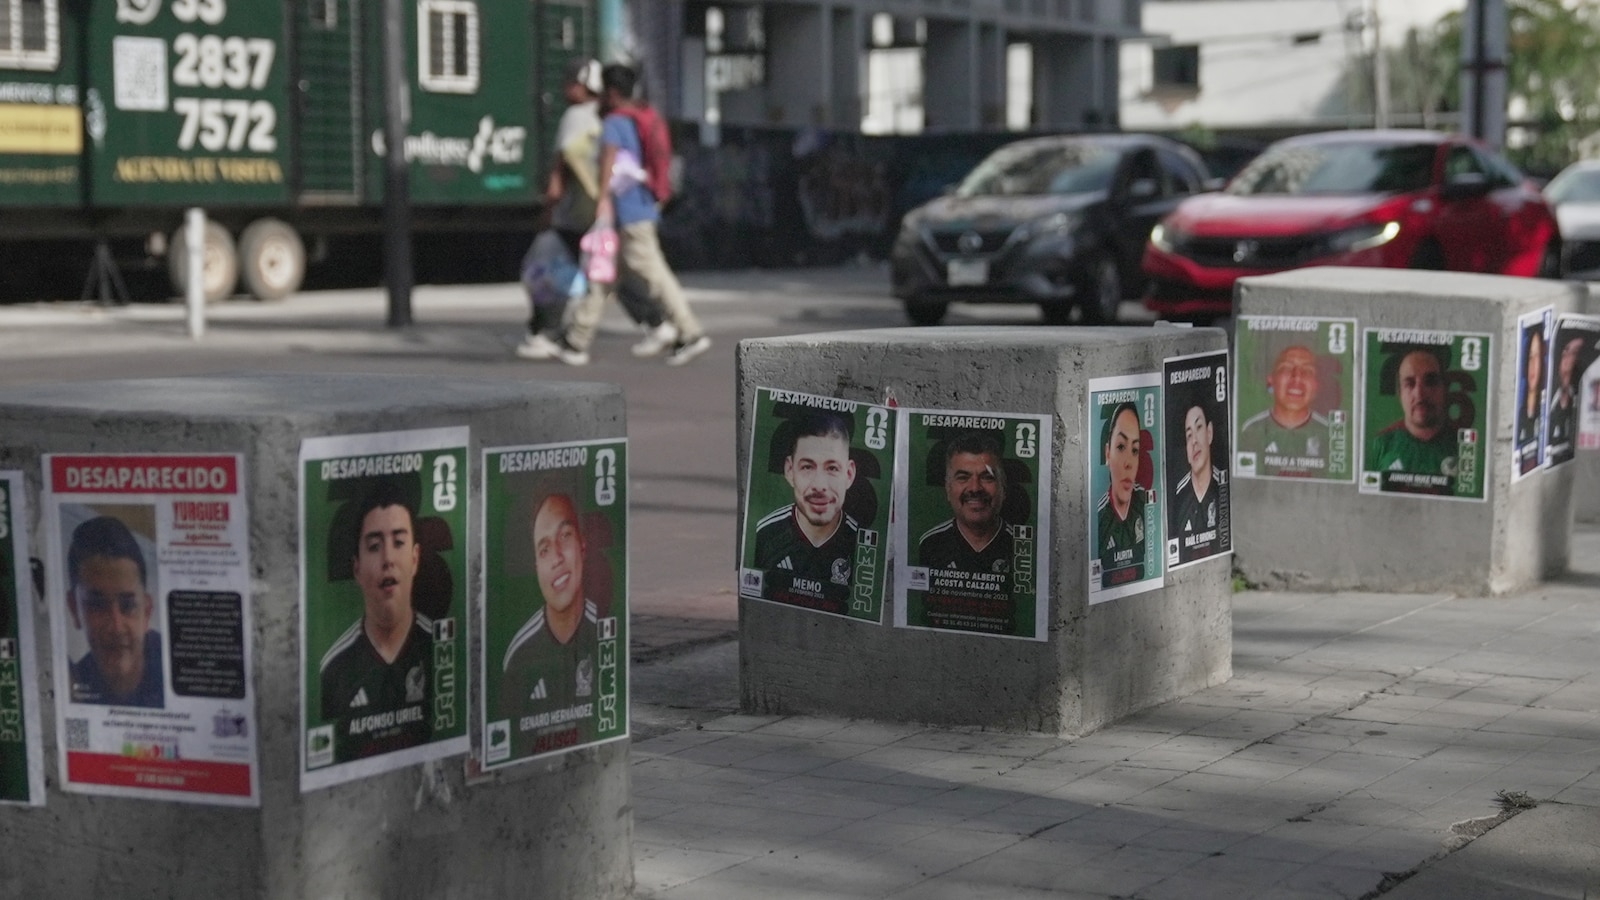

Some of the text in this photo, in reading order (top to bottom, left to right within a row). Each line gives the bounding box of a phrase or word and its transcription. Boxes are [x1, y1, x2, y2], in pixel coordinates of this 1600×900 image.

[173, 33, 276, 90] 2837
[173, 98, 277, 151] 7572
[1248, 319, 1318, 332] DESAPARECIDO
[1377, 331, 1454, 345] DESAPARECIDO
[1170, 366, 1211, 385] DESAPARECIDO
[769, 390, 858, 413] DESAPARECIDO
[1098, 390, 1140, 406] DESAPARECIDA
[922, 414, 1006, 431] DESAPARECIDO
[321, 453, 422, 480] DESAPARECIDO
[500, 447, 587, 473] DESAPARECIDO
[1264, 455, 1289, 467] PABLO
[1296, 457, 1325, 469] TORRES
[66, 466, 227, 489] DESAPARECIDO
[1114, 549, 1134, 562] LAURITA
[929, 569, 1006, 583] FRANCISCO ALBERTO
[792, 577, 822, 593] MEMO
[934, 578, 964, 588] ACOSTA
[965, 581, 1001, 592] CALZADA
[941, 588, 950, 596] de
[950, 590, 984, 598] noviembre
[984, 592, 992, 600] de
[349, 711, 395, 735] ALFONSO
[396, 705, 424, 725] URIEL
[520, 712, 550, 731] GENARO
[551, 703, 593, 725] HERNÁNDEZ
